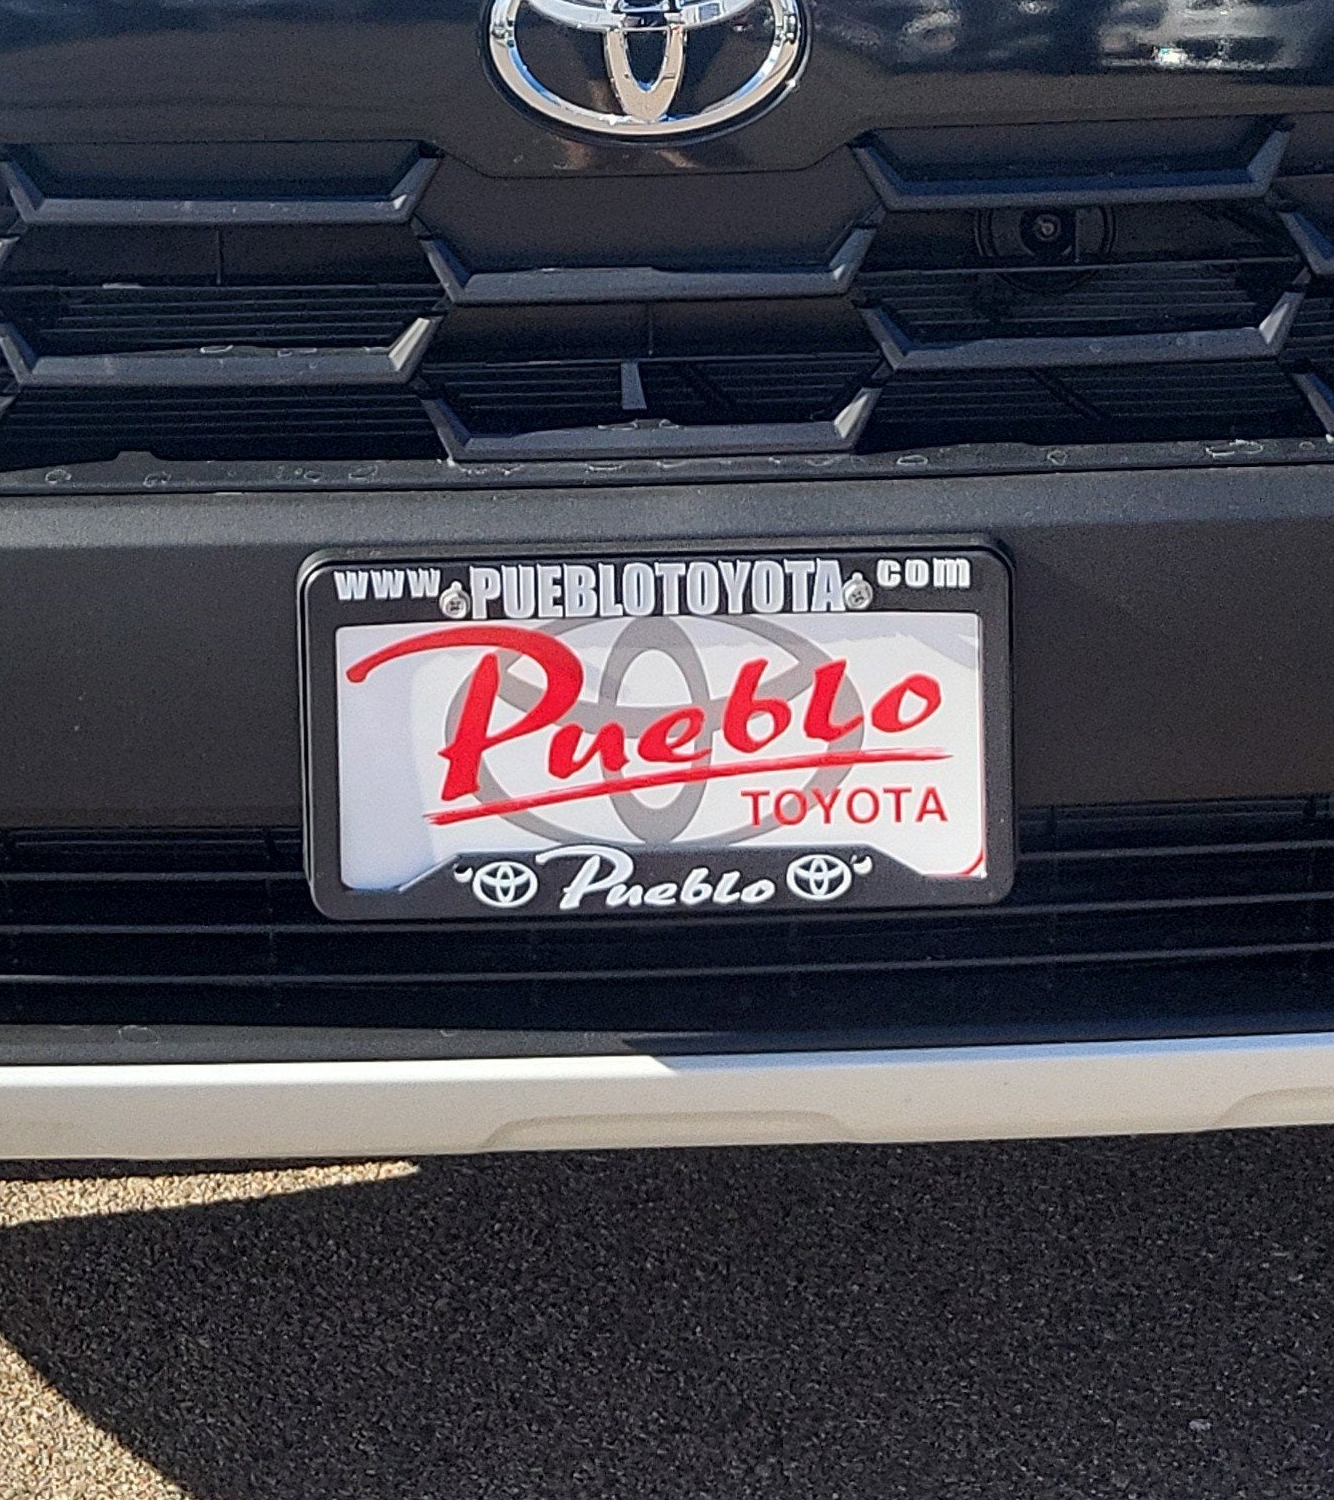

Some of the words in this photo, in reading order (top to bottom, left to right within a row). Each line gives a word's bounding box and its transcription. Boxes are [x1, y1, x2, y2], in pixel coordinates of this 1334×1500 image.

[346, 624, 942, 802] Pueblo
[741, 787, 948, 826] TOYOTA
[535, 844, 776, 910] Pueblo
